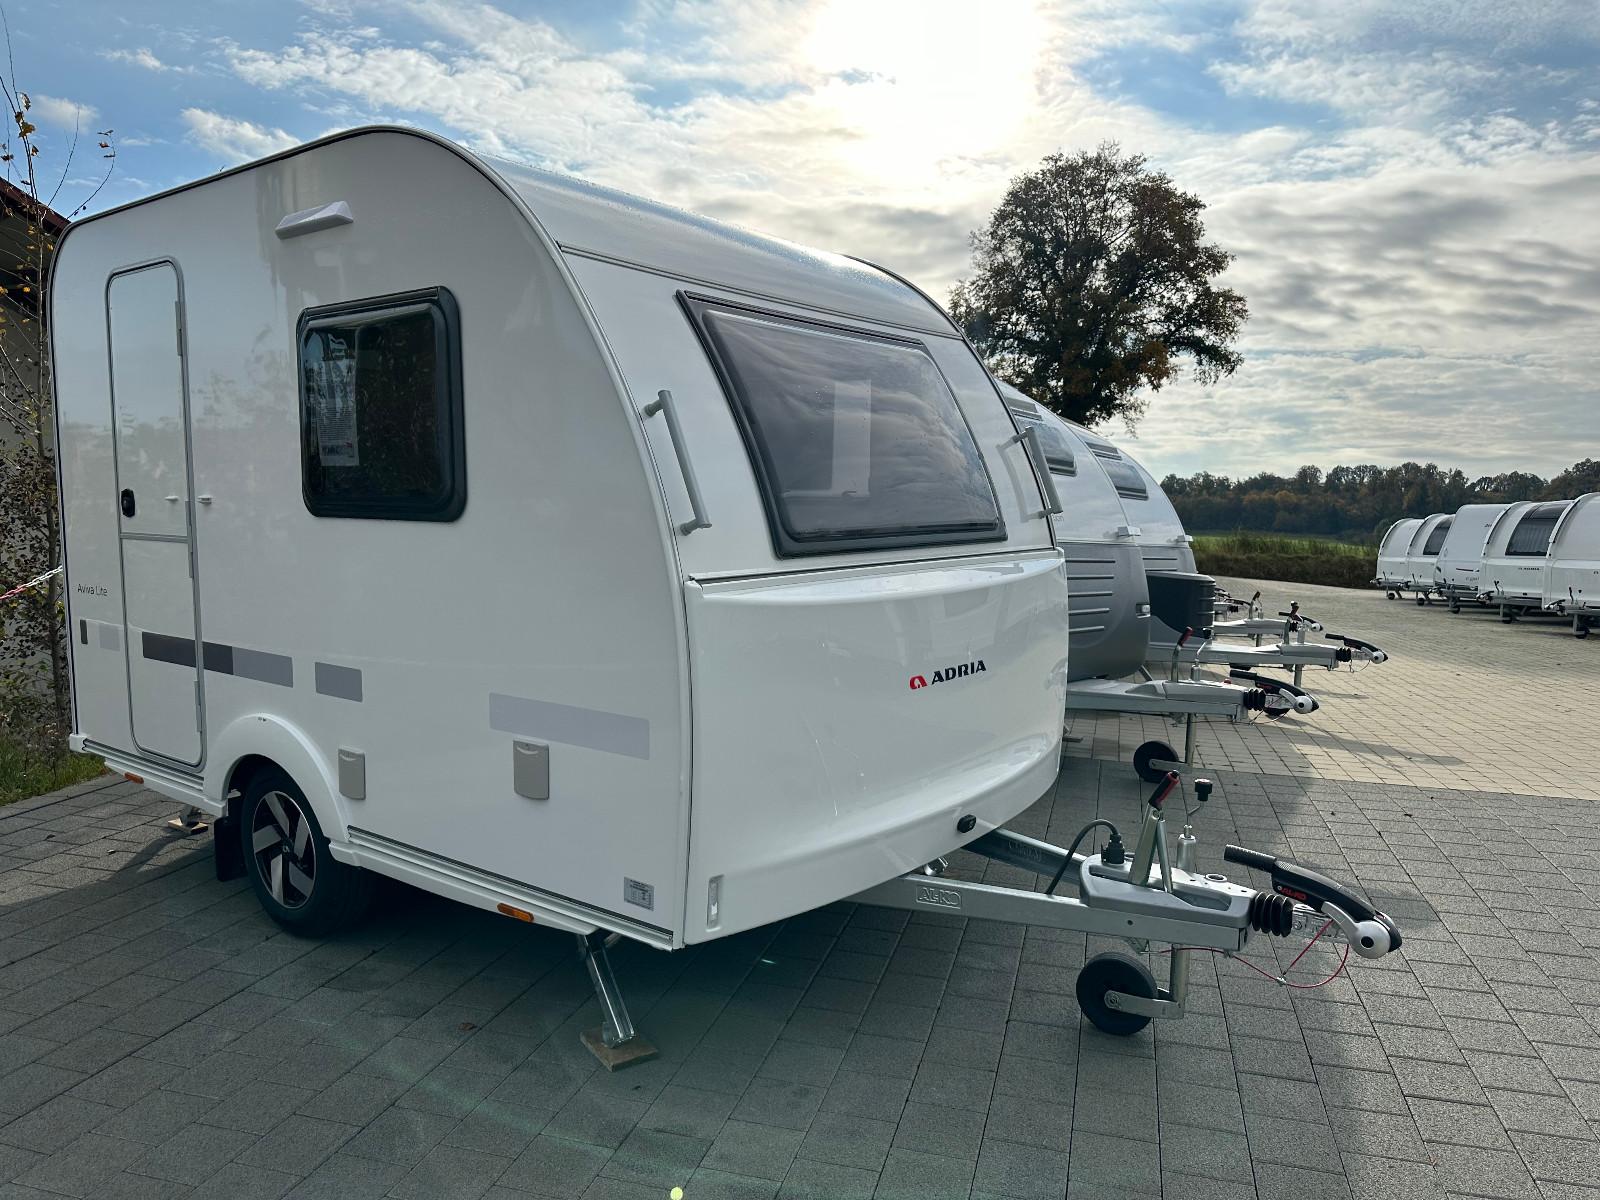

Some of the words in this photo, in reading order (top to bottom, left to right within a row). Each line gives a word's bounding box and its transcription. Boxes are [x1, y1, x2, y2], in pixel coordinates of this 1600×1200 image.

[77, 583, 95, 595] Aviva
[95, 584, 108, 597] Lite
[931, 660, 987, 685] ADRIA
